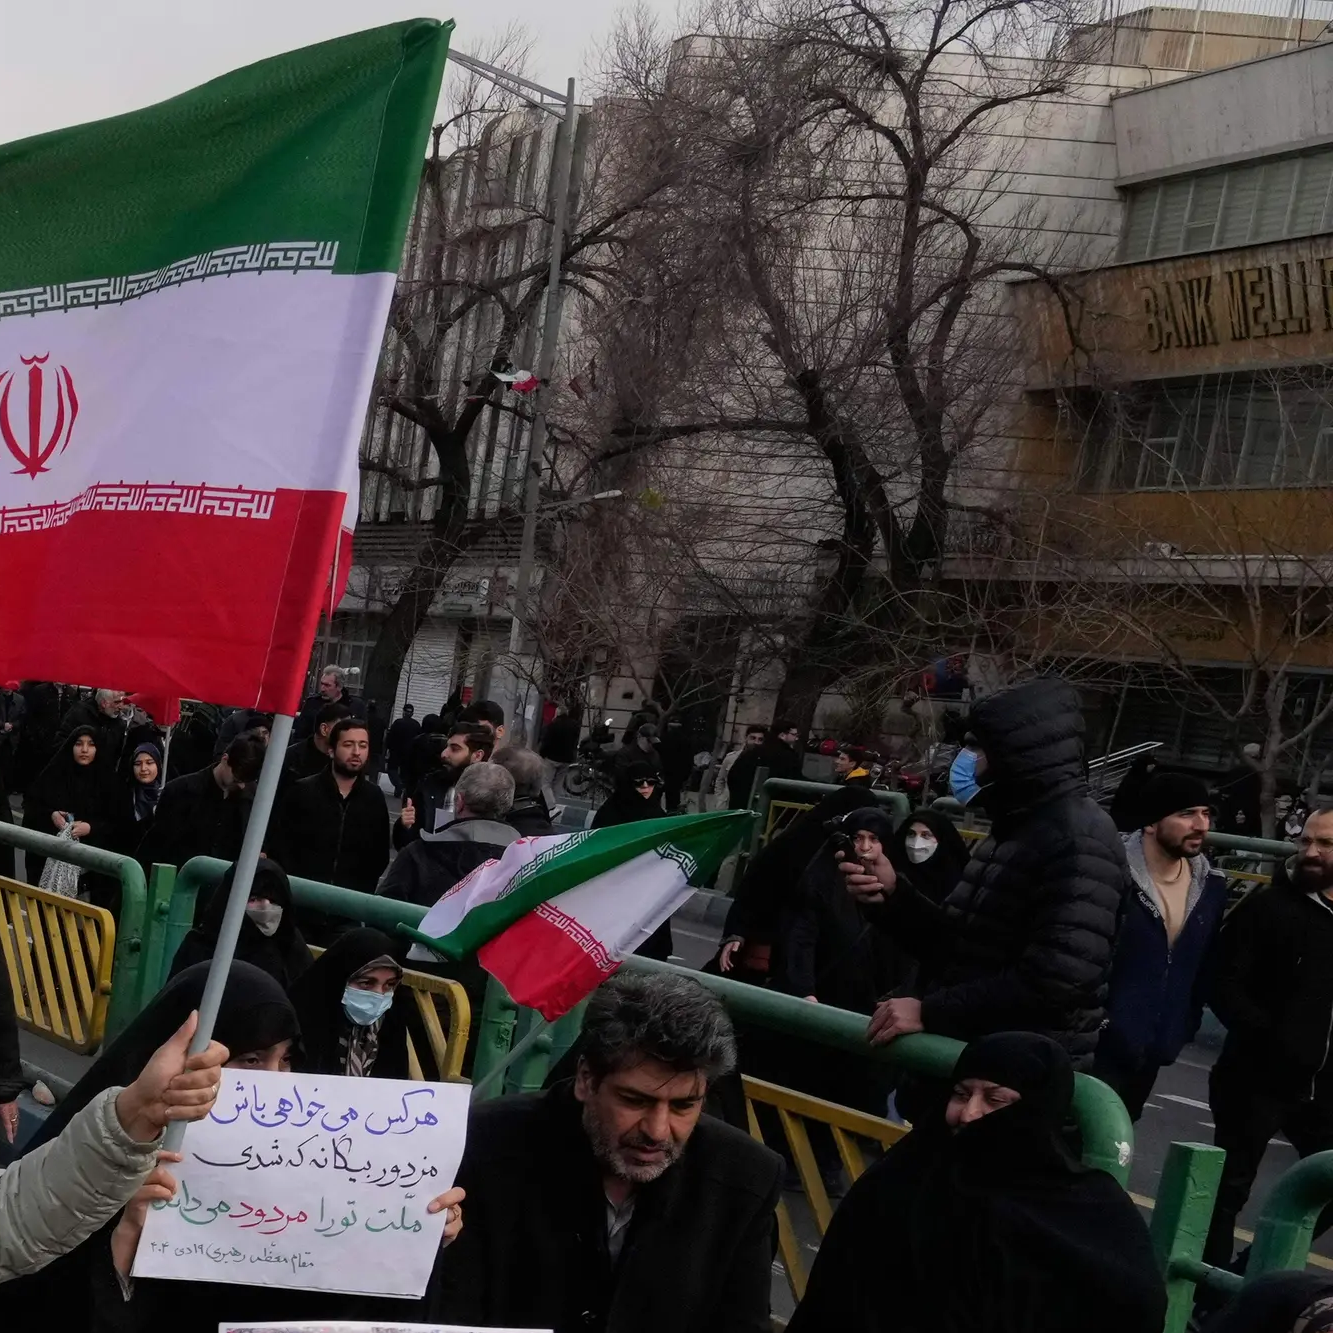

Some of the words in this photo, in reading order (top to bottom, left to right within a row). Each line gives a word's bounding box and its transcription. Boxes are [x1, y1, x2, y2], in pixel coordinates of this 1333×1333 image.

[1141, 278, 1219, 352] BANK
[1225, 261, 1312, 341] MELLI
[209, 1081, 267, 1124] باش
[192, 1139, 283, 1170] شدی
[286, 1134, 319, 1168] که
[361, 1156, 438, 1188] مزدور
[229, 1202, 308, 1235] مردود
[206, 1242, 246, 1264] رهبری
[290, 1251, 314, 1273] مقام
